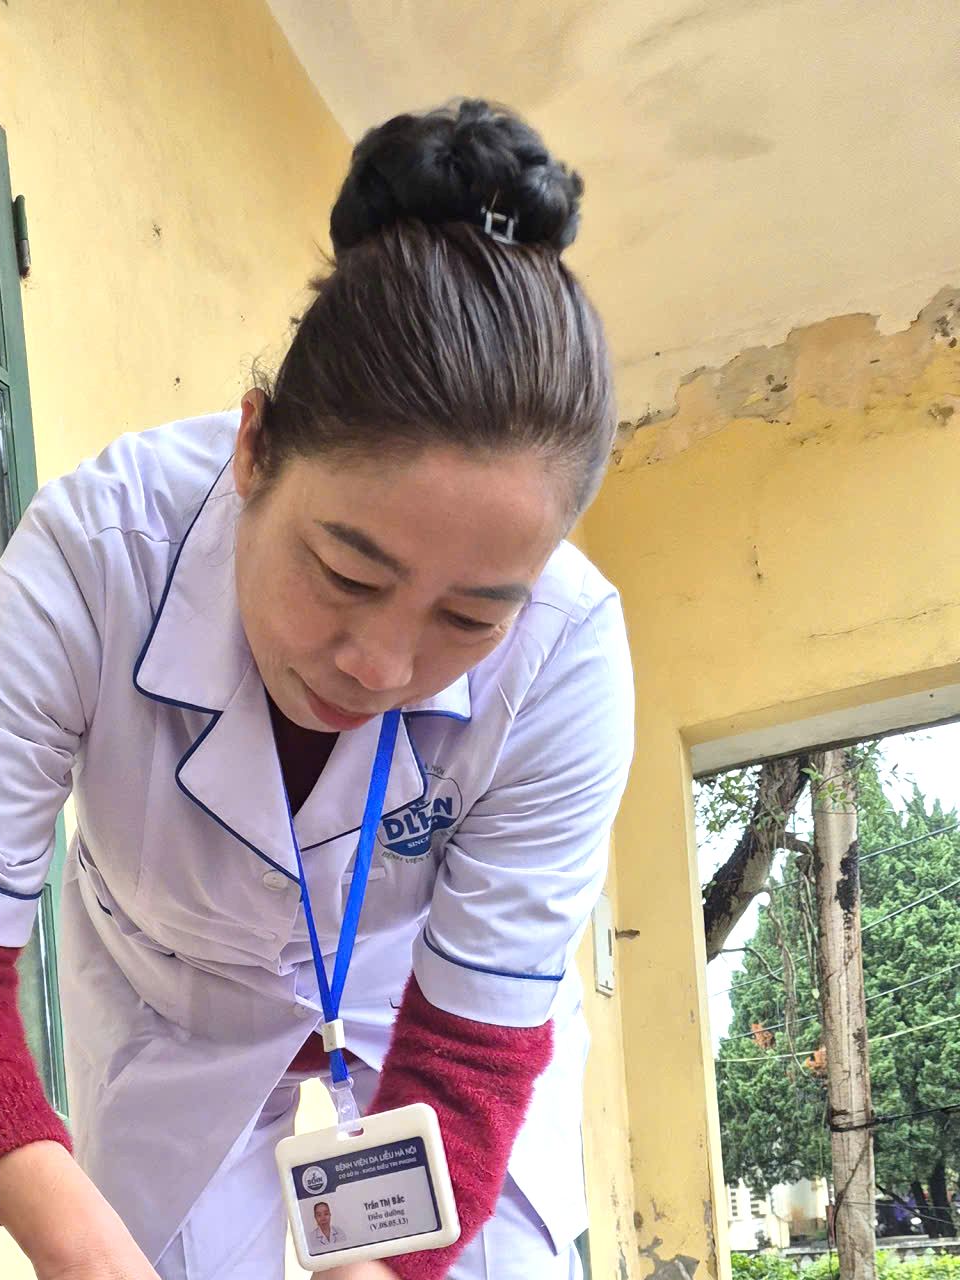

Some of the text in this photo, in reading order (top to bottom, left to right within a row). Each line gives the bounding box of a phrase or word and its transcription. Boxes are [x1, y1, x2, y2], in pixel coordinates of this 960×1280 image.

[395, 1148, 405, 1157] HÀ
[405, 1145, 417, 1155] NỘI
[380, 1197, 391, 1208] Thị
